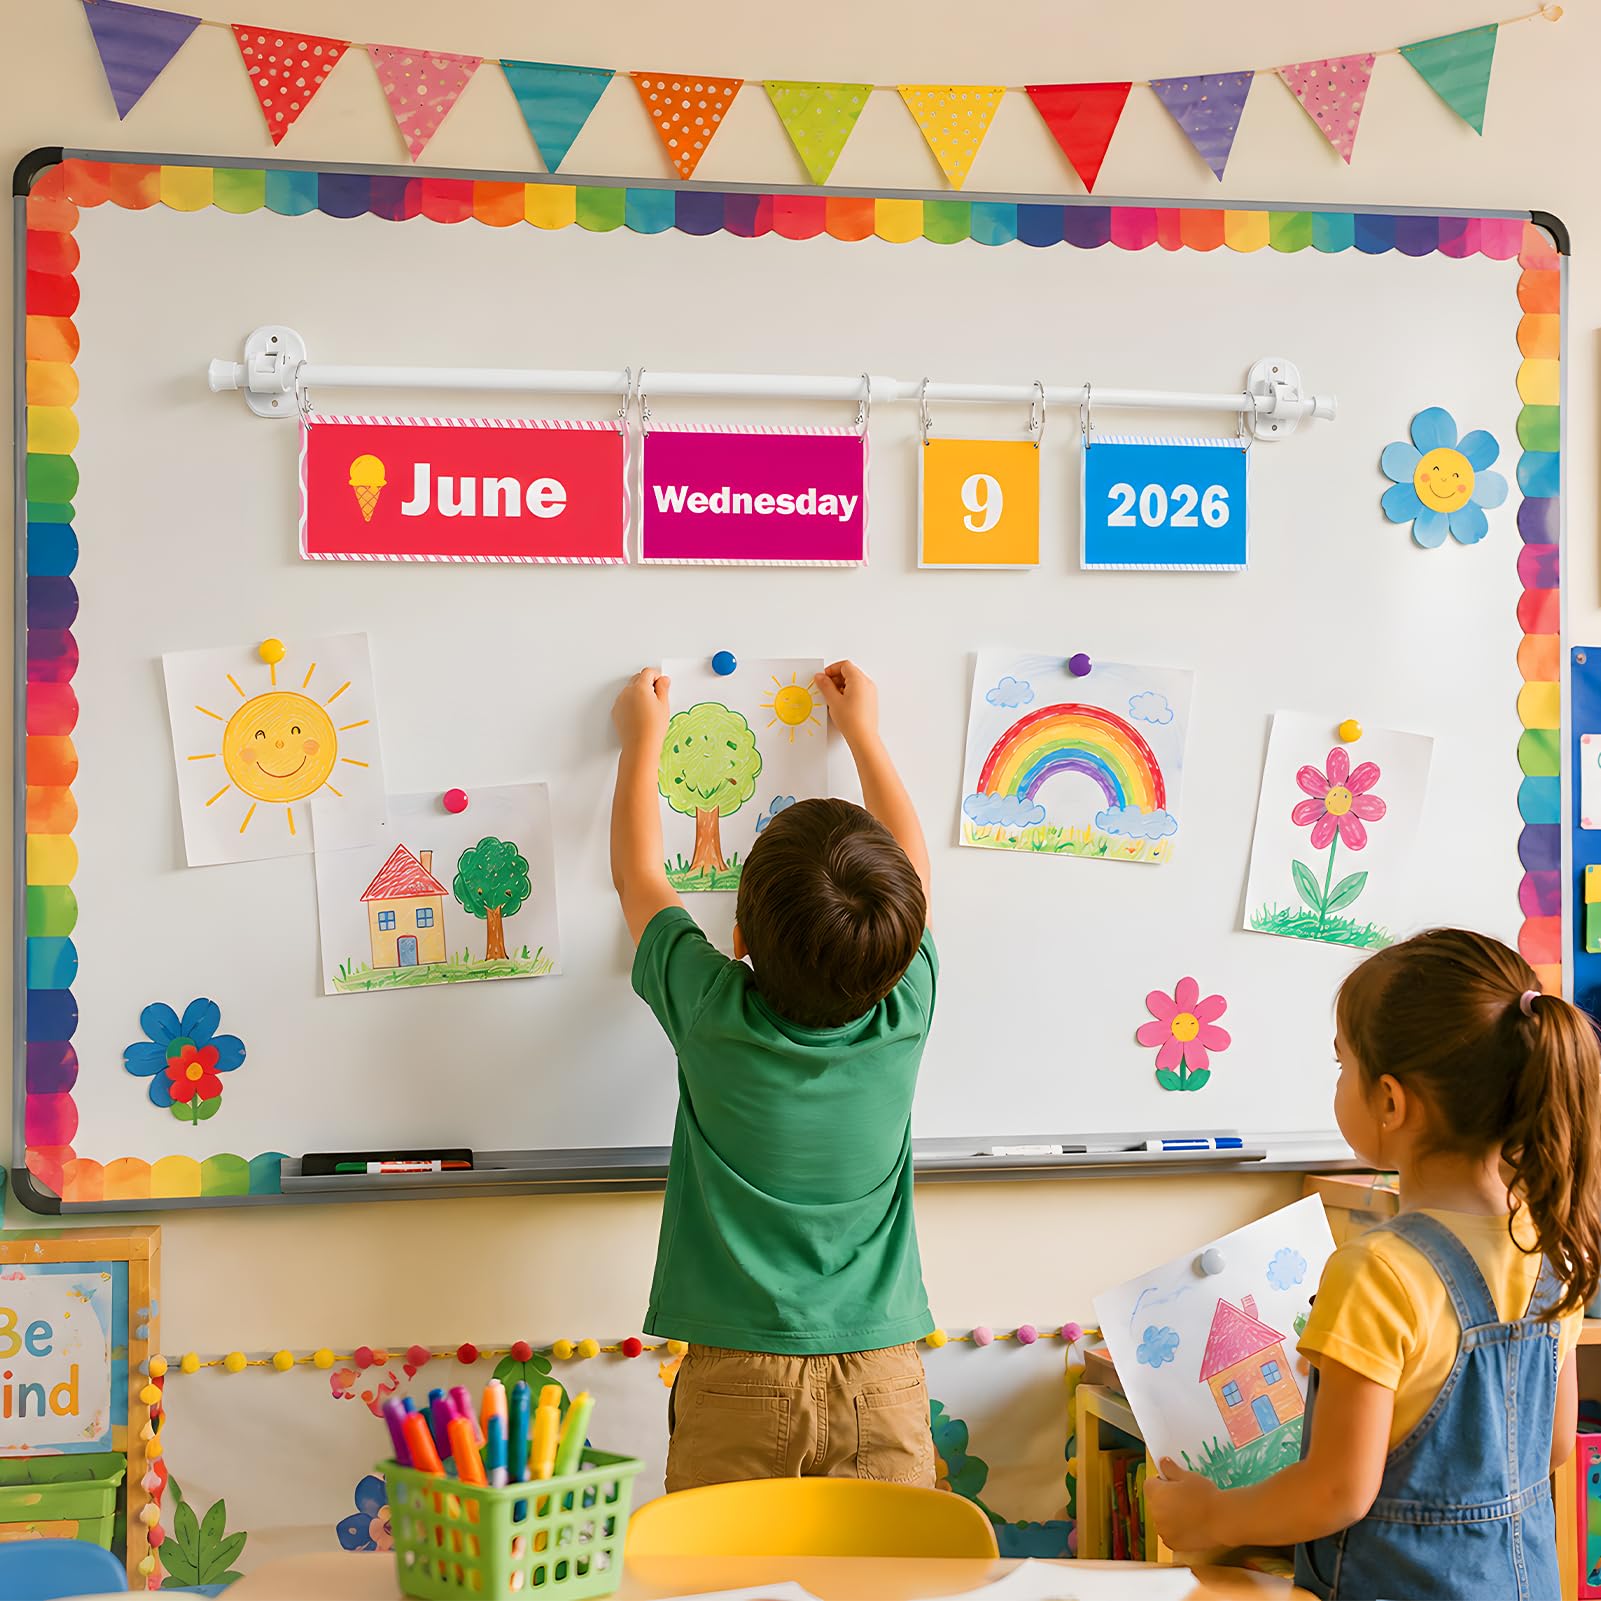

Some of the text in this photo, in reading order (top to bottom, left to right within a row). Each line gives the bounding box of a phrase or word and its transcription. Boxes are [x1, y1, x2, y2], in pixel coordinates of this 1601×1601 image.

[402, 463, 567, 518] June
[653, 486, 859, 522] Wednesday
[962, 474, 1003, 533] 9
[1107, 483, 1230, 528] 2026
[0, 1307, 53, 1358] Be
[0, 1364, 79, 1418] ind
